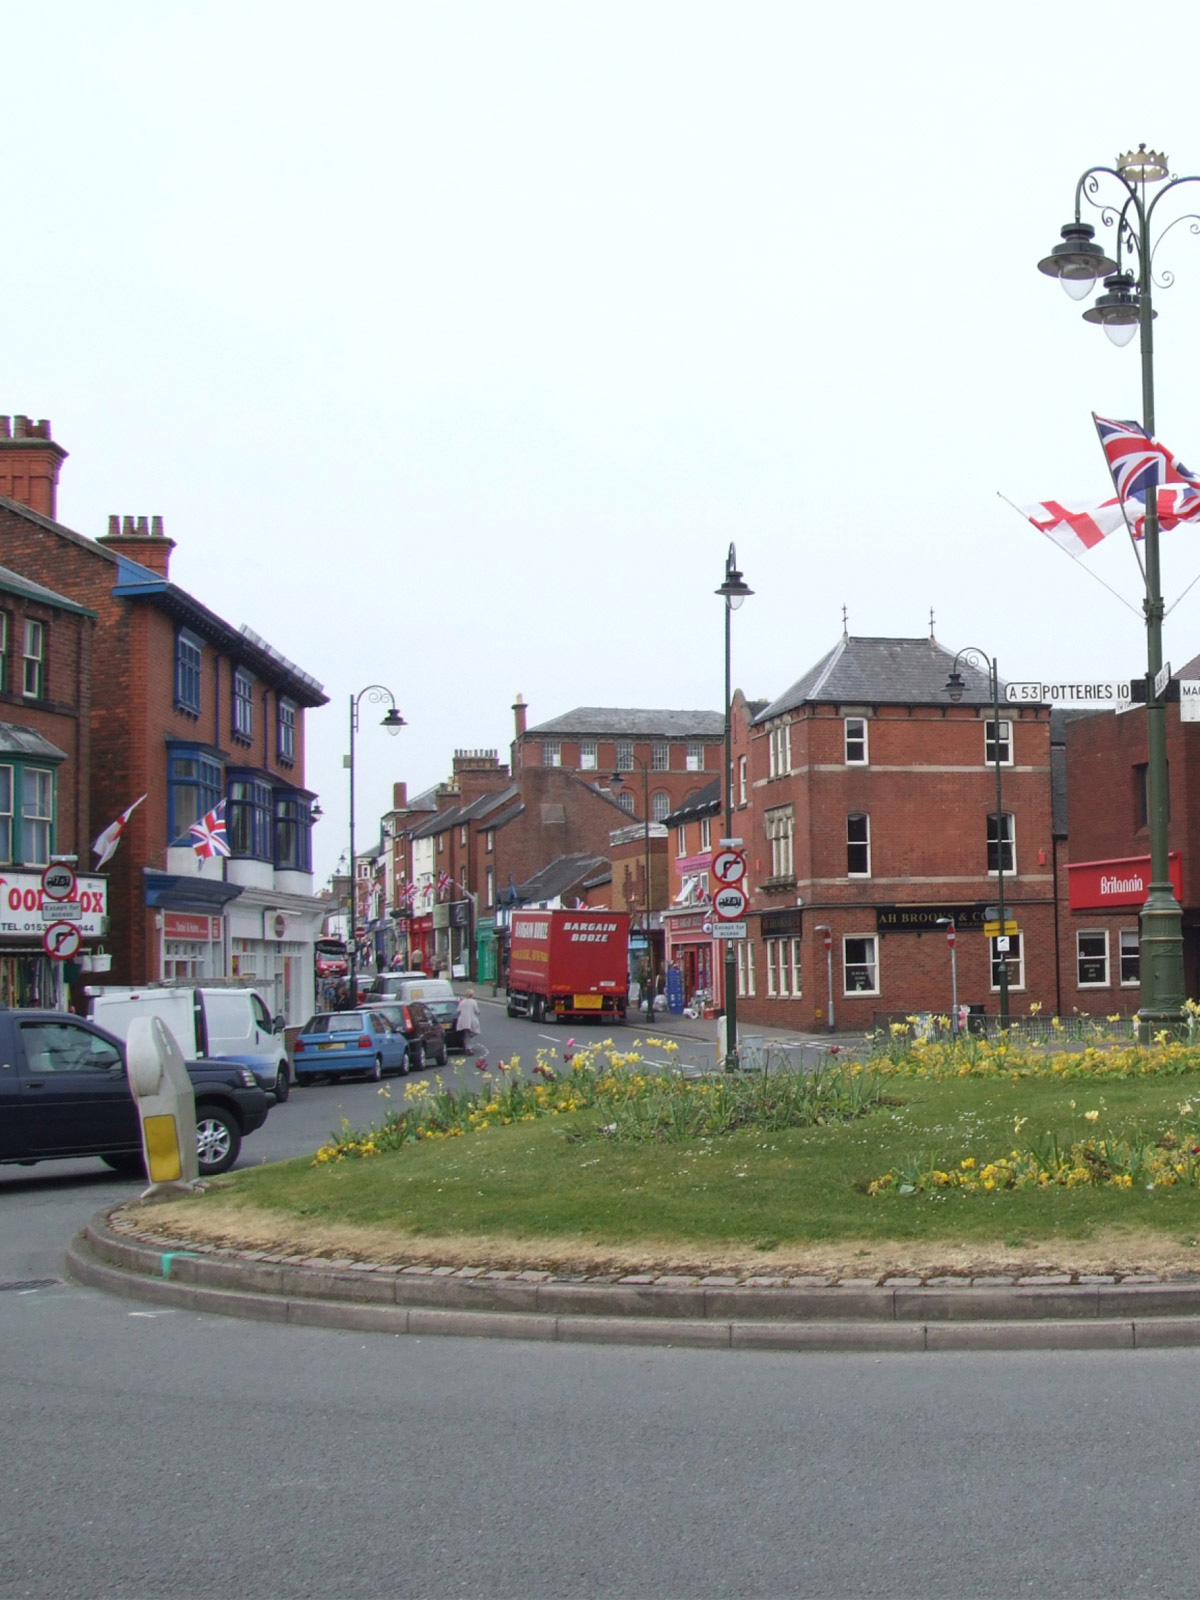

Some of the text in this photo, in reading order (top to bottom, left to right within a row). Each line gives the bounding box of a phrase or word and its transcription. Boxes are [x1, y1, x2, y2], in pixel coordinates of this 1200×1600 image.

[1021, 686, 1038, 699] 53
[1042, 684, 1113, 700] POTTERIES
[1117, 684, 1129, 699] 10
[1100, 873, 1144, 895] Britannia
[45, 904, 69, 912] Except
[879, 912, 898, 924] AH
[901, 910, 955, 923] BROOKS
[958, 911, 968, 921] &
[563, 921, 618, 932] BARGAIN
[714, 924, 735, 932] Except
[570, 933, 609, 943] BOOZE
